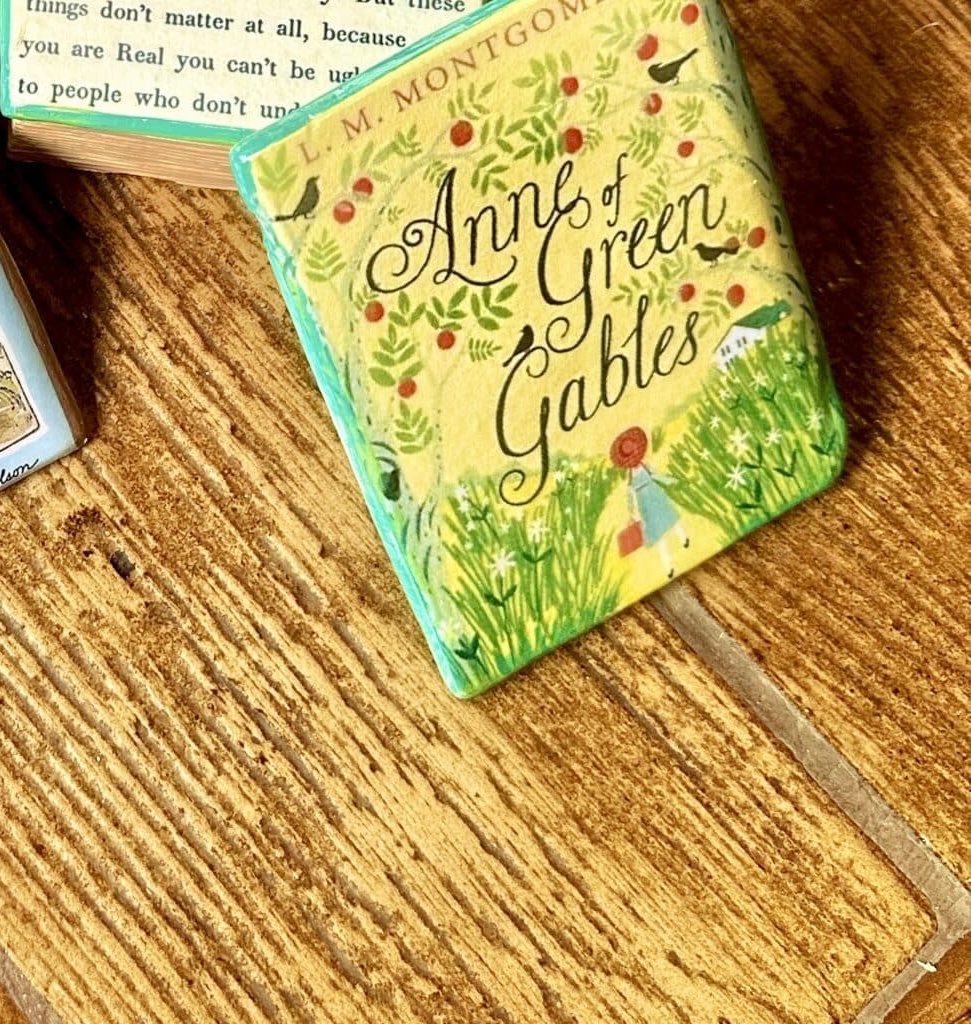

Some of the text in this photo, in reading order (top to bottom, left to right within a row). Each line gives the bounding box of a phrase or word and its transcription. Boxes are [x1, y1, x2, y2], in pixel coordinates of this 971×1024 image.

[99, 1, 153, 23] don't
[164, 8, 235, 31] matter
[244, 17, 267, 35] at
[276, 17, 311, 43] all,
[321, 22, 408, 49] because
[18, 37, 61, 57] you
[70, 42, 106, 59] are
[116, 42, 165, 66] Real
[173, 52, 216, 73] you
[226, 56, 279, 77] can't
[290, 60, 316, 81] be
[17, 77, 39, 95] to
[50, 80, 123, 105] people
[134, 88, 181, 109] who
[191, 94, 248, 118] don't
[297, 141, 333, 167] L.
[339, 108, 385, 142] M.
[365, 152, 630, 294] Anne of
[537, 183, 727, 354] Green
[495, 294, 700, 506] Gables
